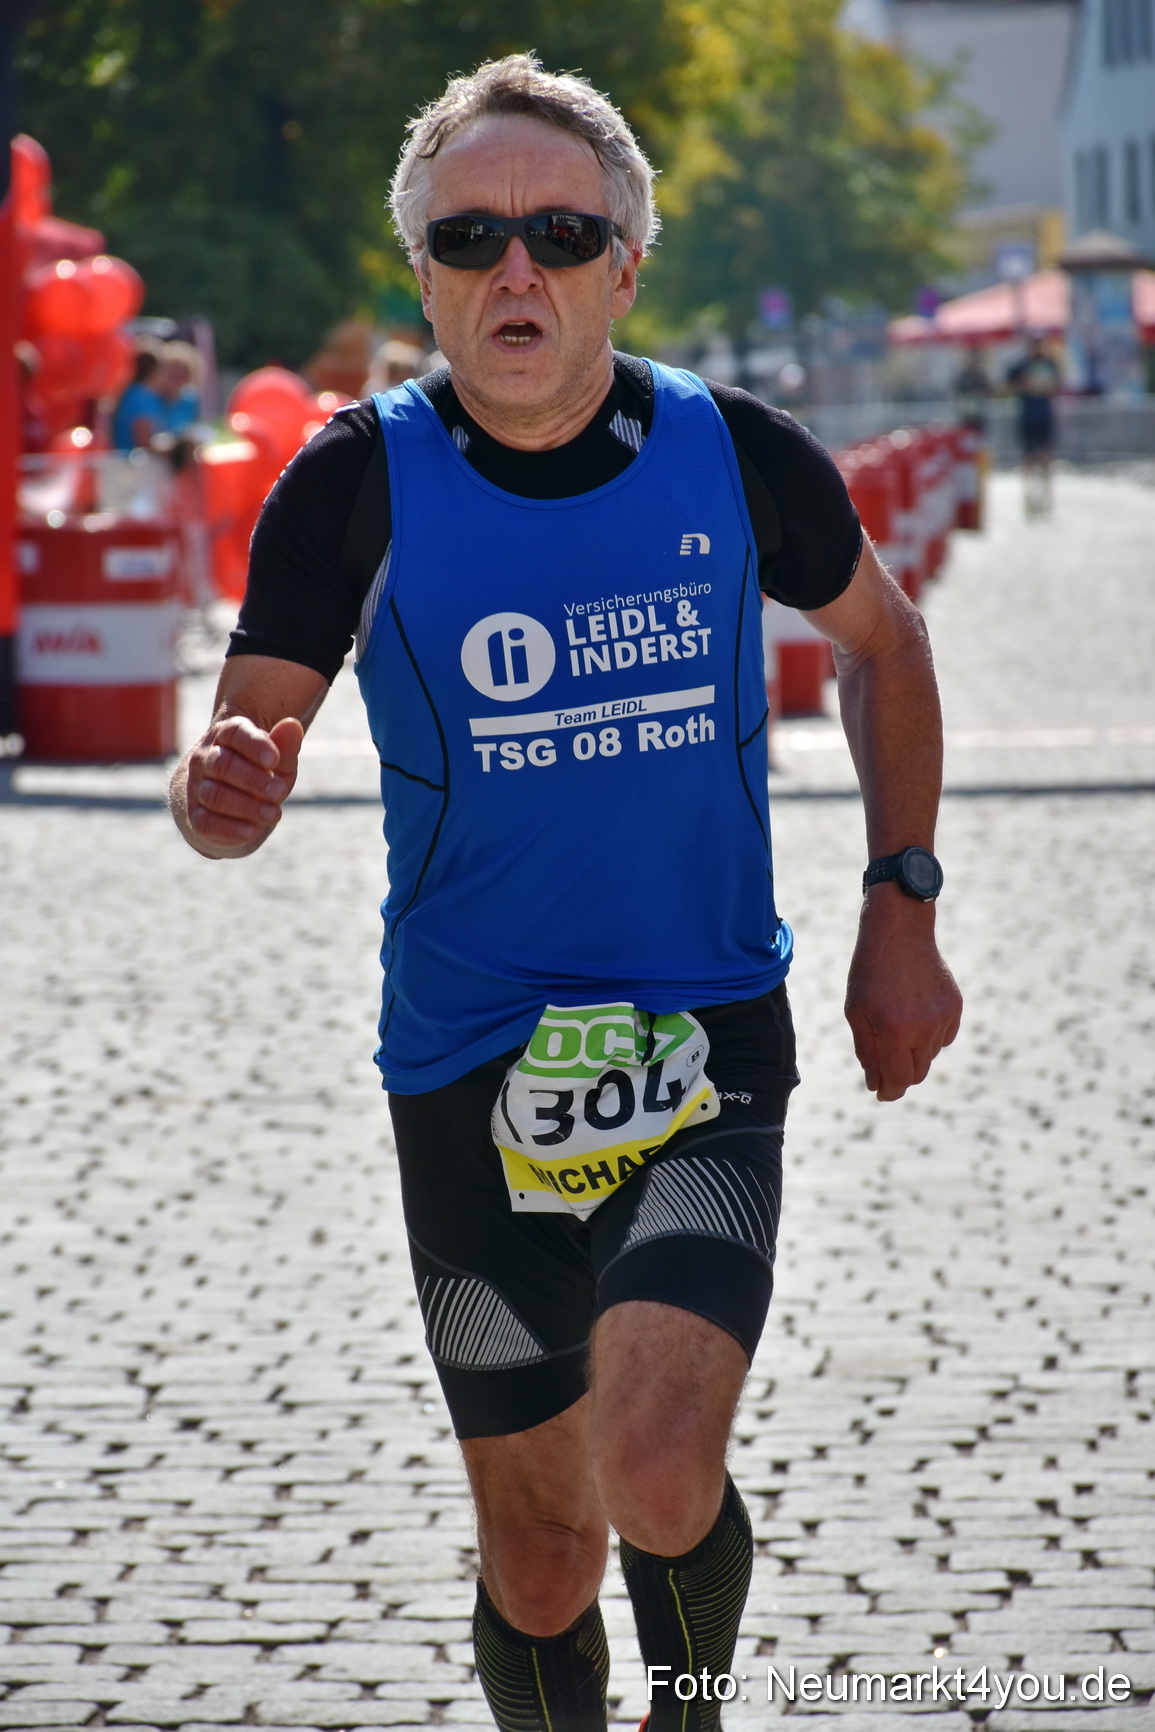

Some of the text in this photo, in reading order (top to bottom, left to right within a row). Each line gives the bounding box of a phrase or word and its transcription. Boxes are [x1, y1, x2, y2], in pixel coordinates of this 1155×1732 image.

[564, 582, 712, 617] Versicherungsbüro
[565, 600, 700, 646] LEIDL &
[569, 628, 712, 677] INDERST
[554, 699, 648, 726] Team LEIDL
[473, 713, 715, 772] TSG 08 Roth
